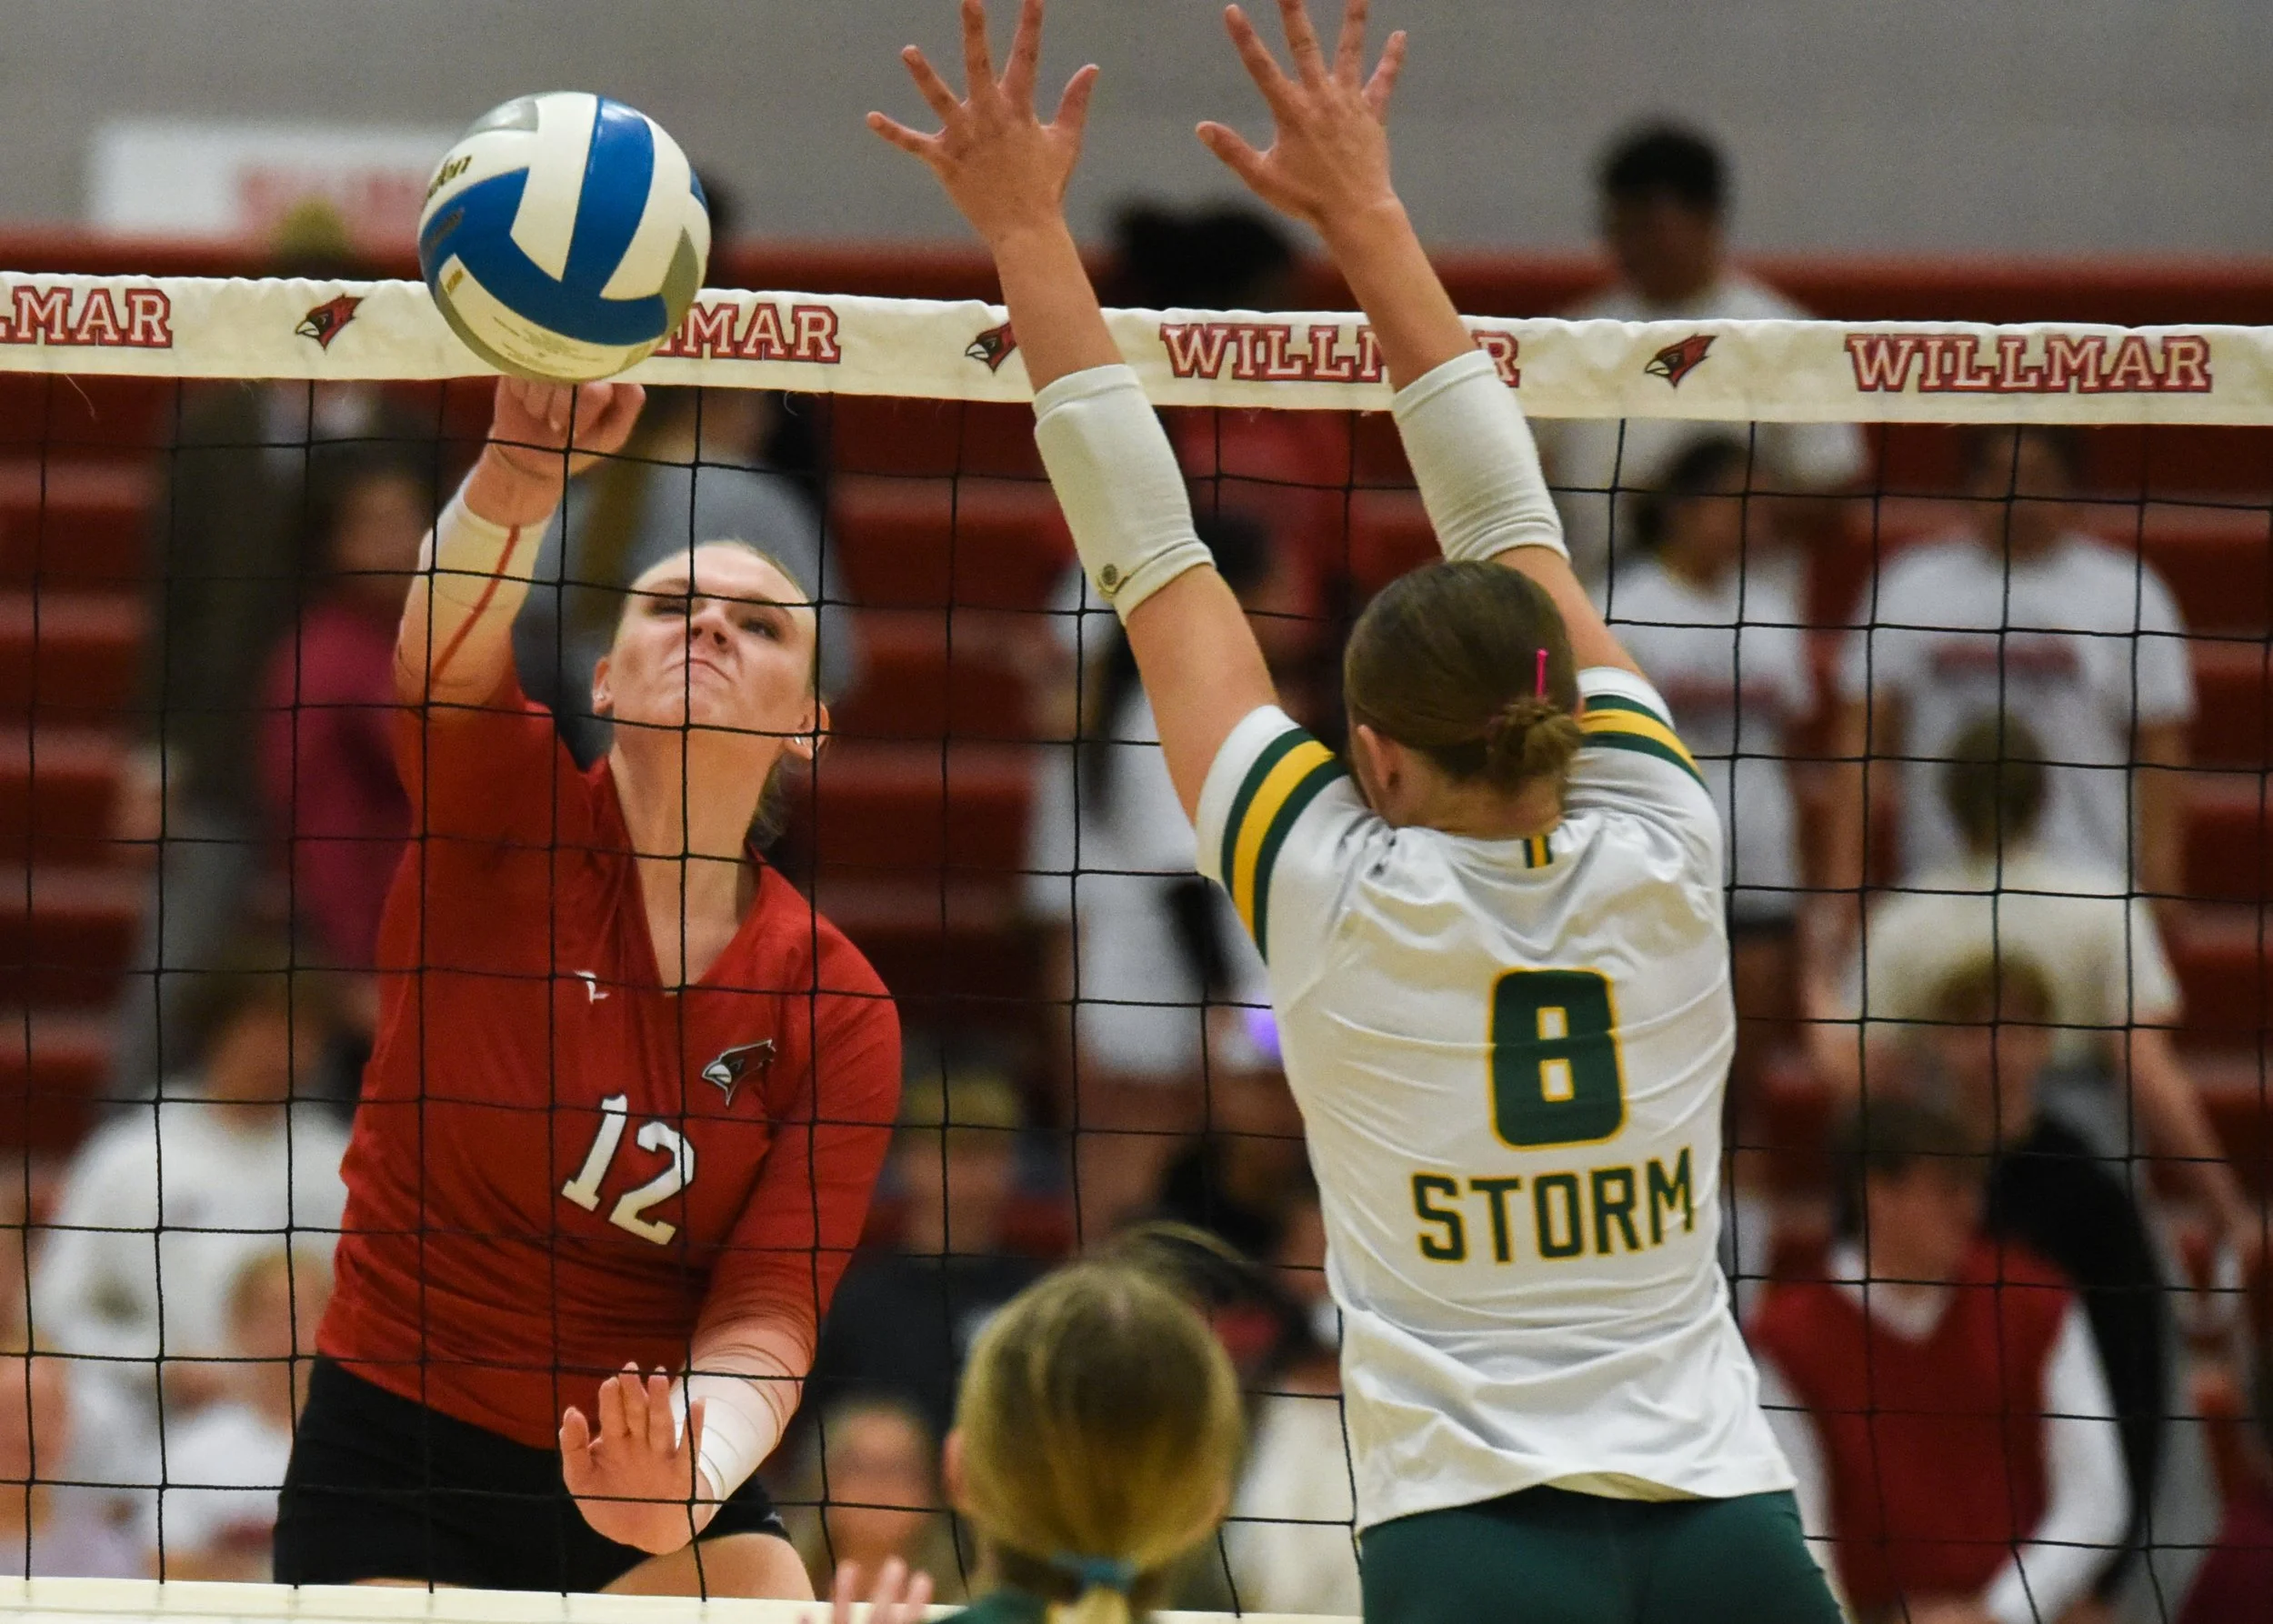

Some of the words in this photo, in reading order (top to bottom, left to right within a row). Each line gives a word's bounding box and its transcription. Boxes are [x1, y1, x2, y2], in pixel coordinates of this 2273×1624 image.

[0, 286, 173, 347] MAR
[652, 302, 840, 364] MAR
[1844, 334, 2213, 393] WILLMAR
[1487, 966, 1628, 1151] 8
[561, 1093, 696, 1245] 12
[1410, 1142, 1696, 1264] STORM
